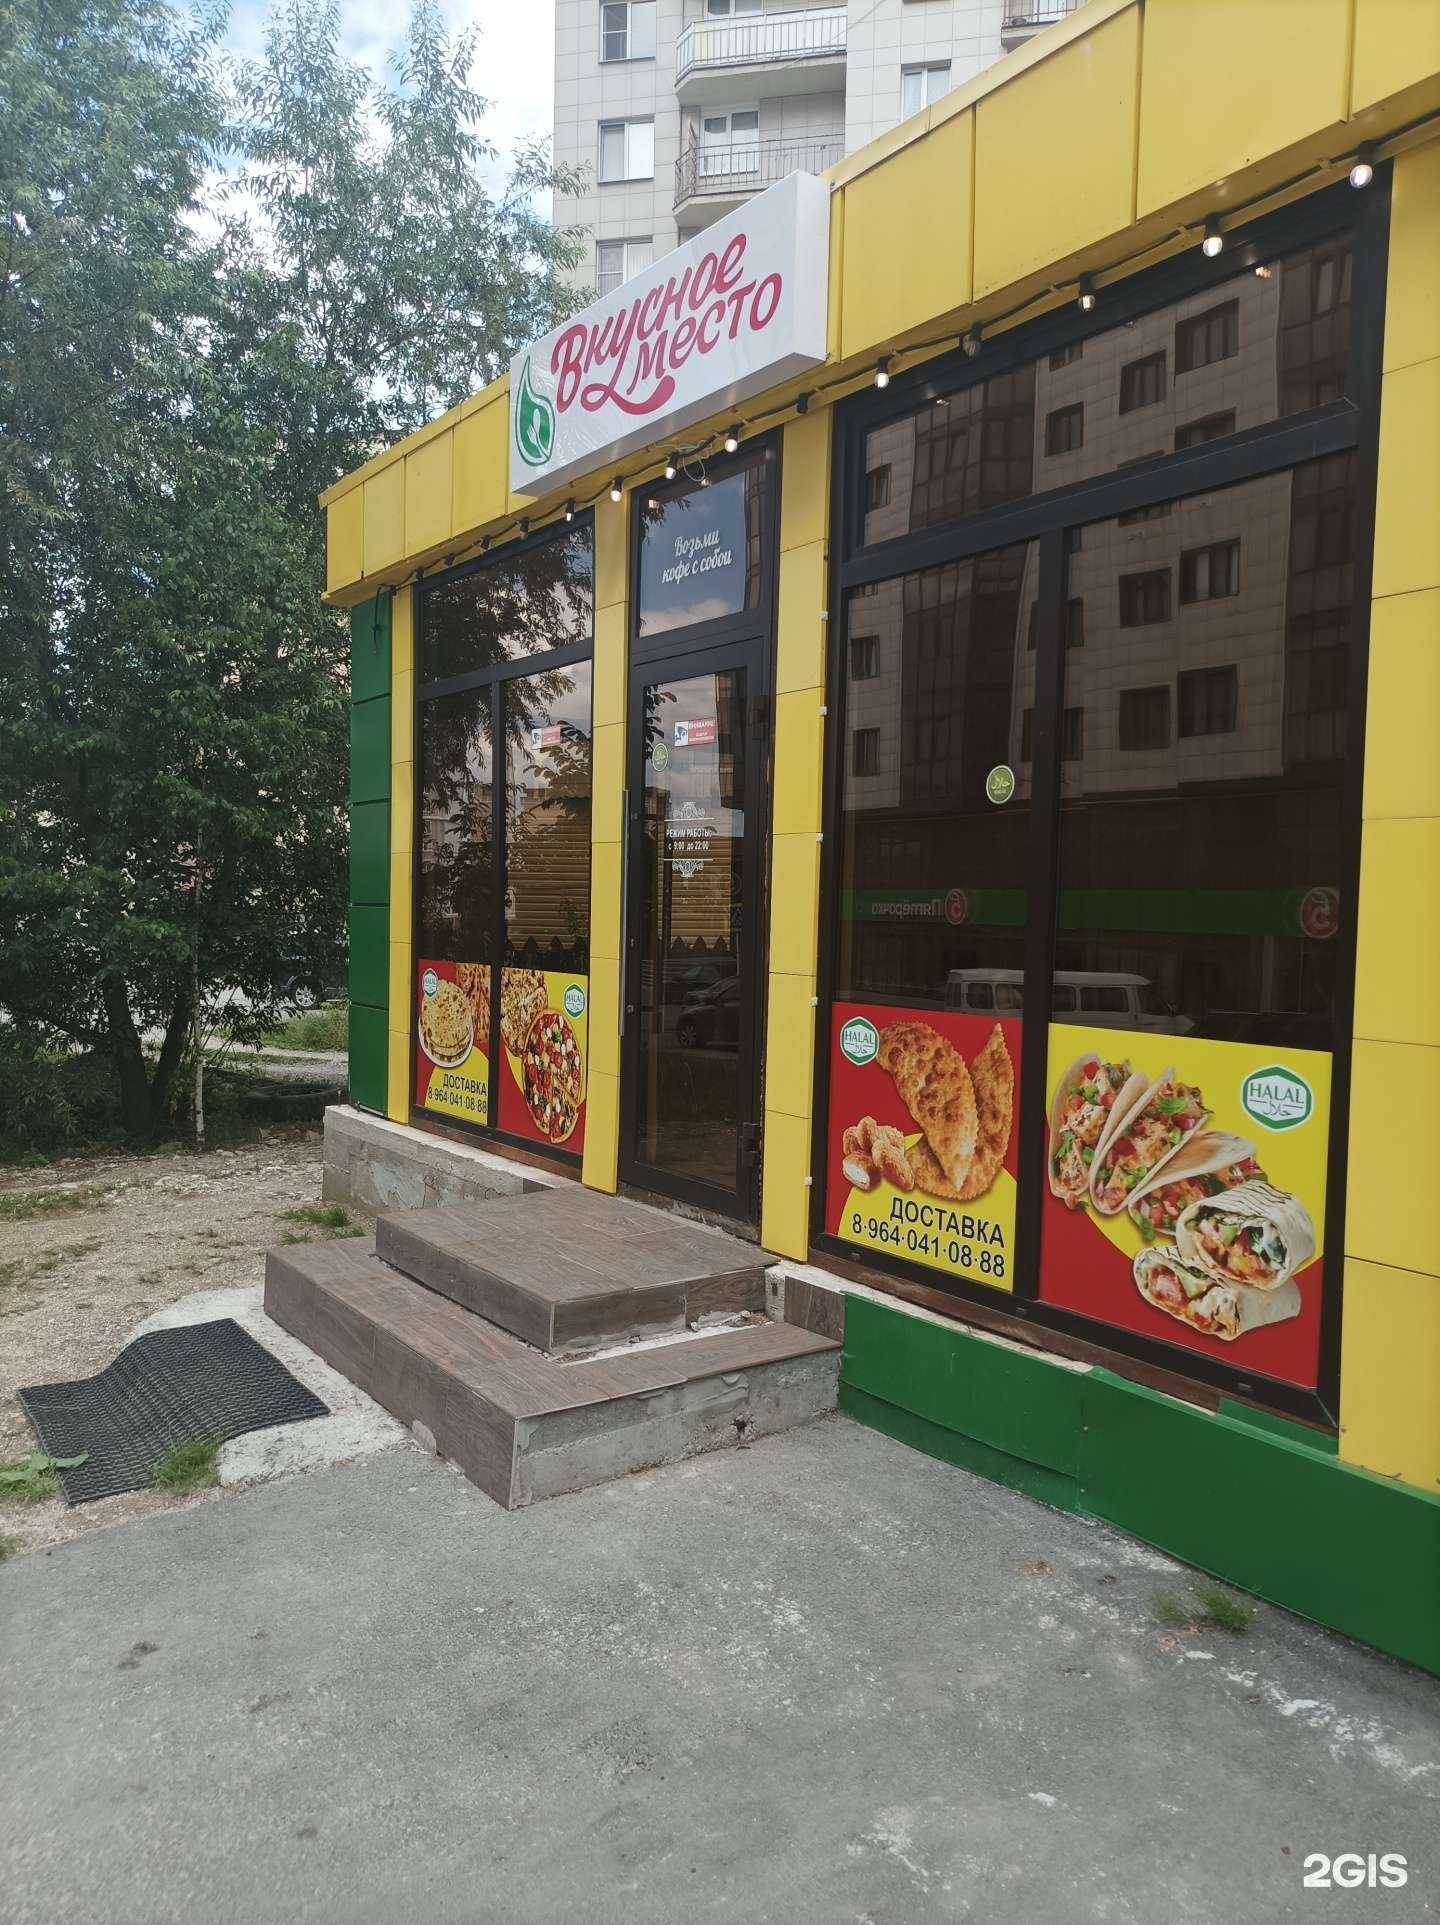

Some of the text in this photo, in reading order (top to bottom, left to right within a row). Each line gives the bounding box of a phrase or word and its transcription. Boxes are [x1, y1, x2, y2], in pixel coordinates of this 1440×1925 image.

[551, 233, 747, 415] Вкусное
[674, 530, 720, 557] Возьми
[662, 560, 690, 584] кофе
[691, 560, 699, 574] с
[666, 828, 686, 838] РЕЖИМ
[845, 1030, 875, 1045] HALAL
[443, 1073, 487, 1096] ДОСТАВКА
[1250, 1082, 1305, 1104] HALAL
[889, 1197, 1005, 1248] ДОСТАВКА
